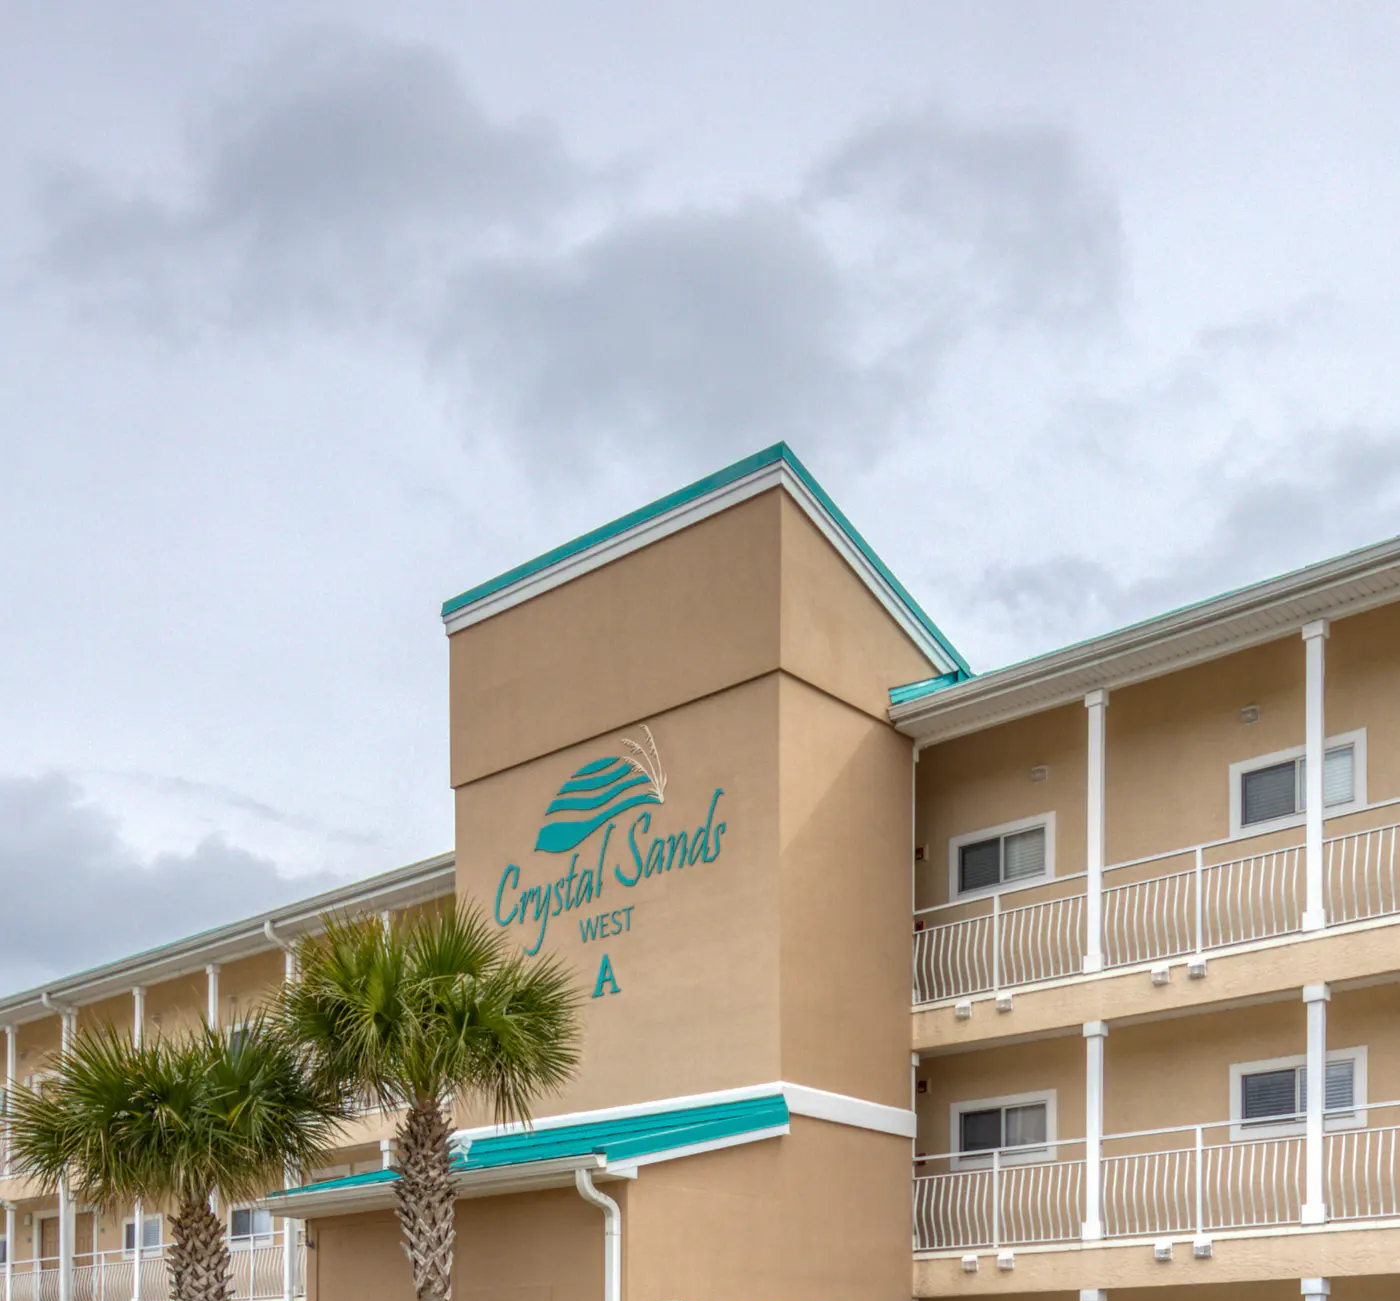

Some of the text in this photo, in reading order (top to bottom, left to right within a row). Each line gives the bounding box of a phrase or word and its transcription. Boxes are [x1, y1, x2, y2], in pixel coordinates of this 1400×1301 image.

[494, 788, 726, 956] Crystal Sands
[579, 905, 635, 943] WEST
[591, 953, 621, 998] A
